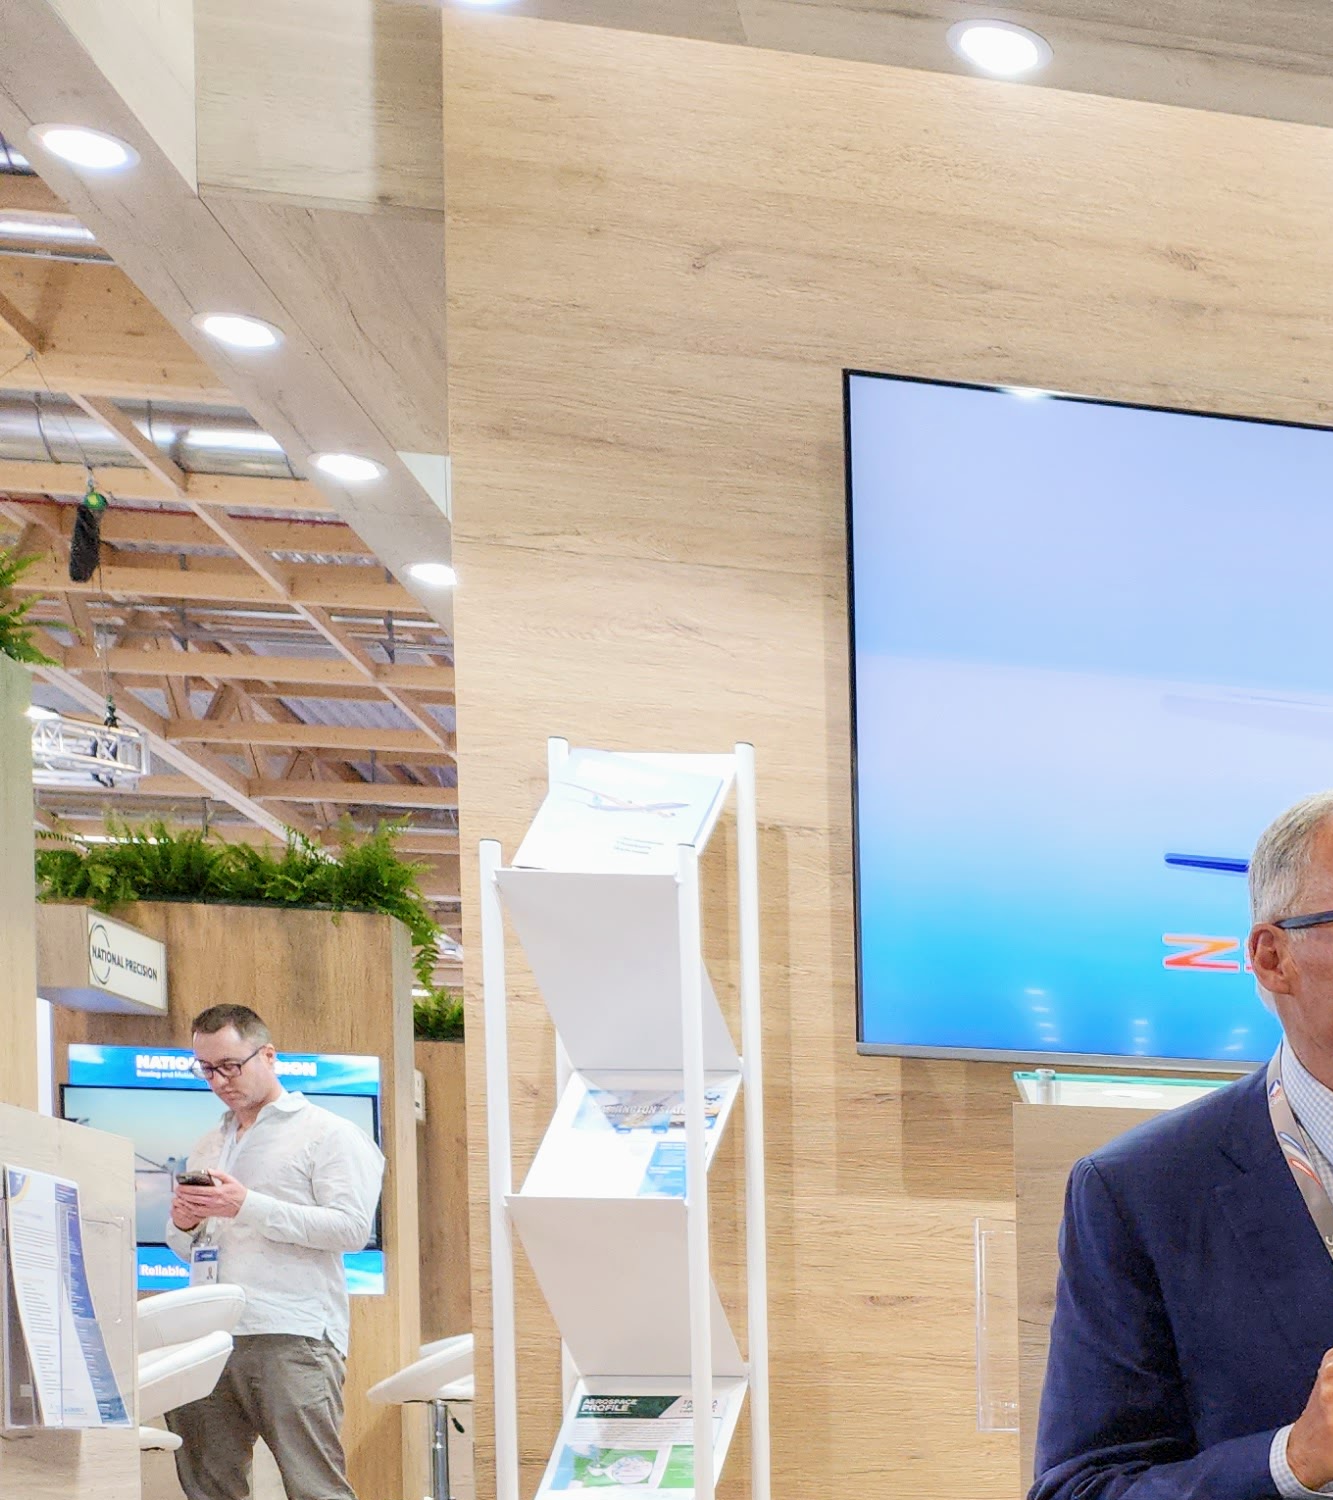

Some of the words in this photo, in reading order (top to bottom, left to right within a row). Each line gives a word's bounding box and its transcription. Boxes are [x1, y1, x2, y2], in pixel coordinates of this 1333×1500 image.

[92, 944, 124, 969] NATIONAL
[125, 957, 158, 983] PRECISION
[580, 1404, 631, 1412] PROFILE
